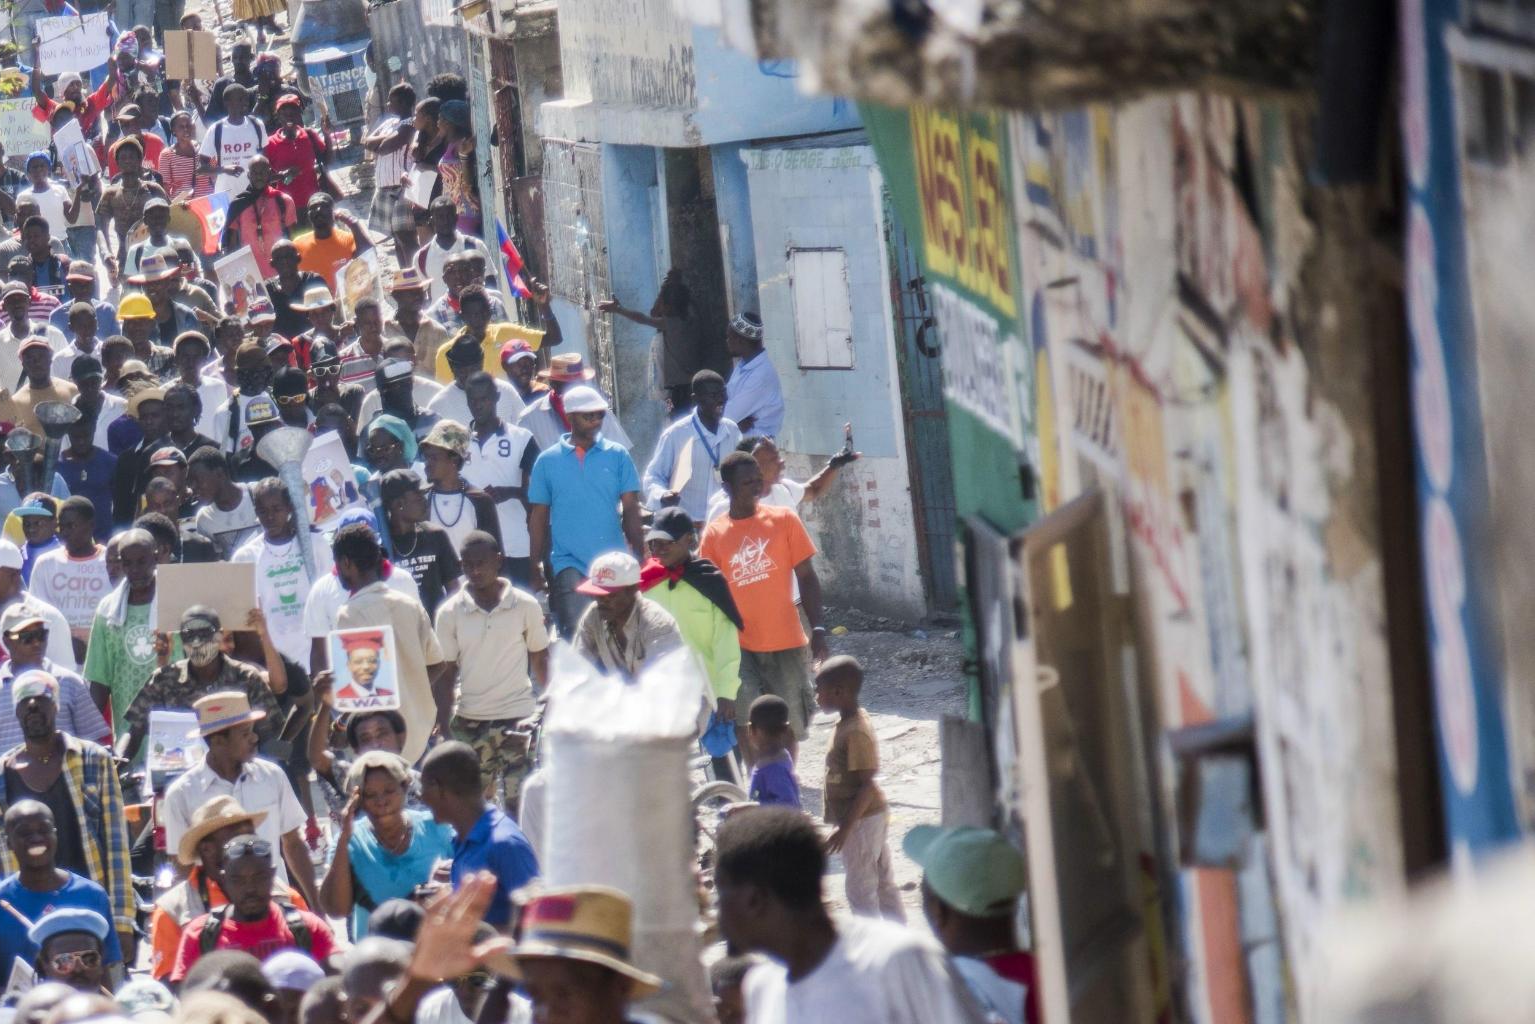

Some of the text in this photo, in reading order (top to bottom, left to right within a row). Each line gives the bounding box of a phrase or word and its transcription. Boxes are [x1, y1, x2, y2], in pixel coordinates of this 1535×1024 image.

[498, 439, 511, 458] 9
[732, 560, 772, 581] CAMP
[53, 572, 103, 592] Caro
